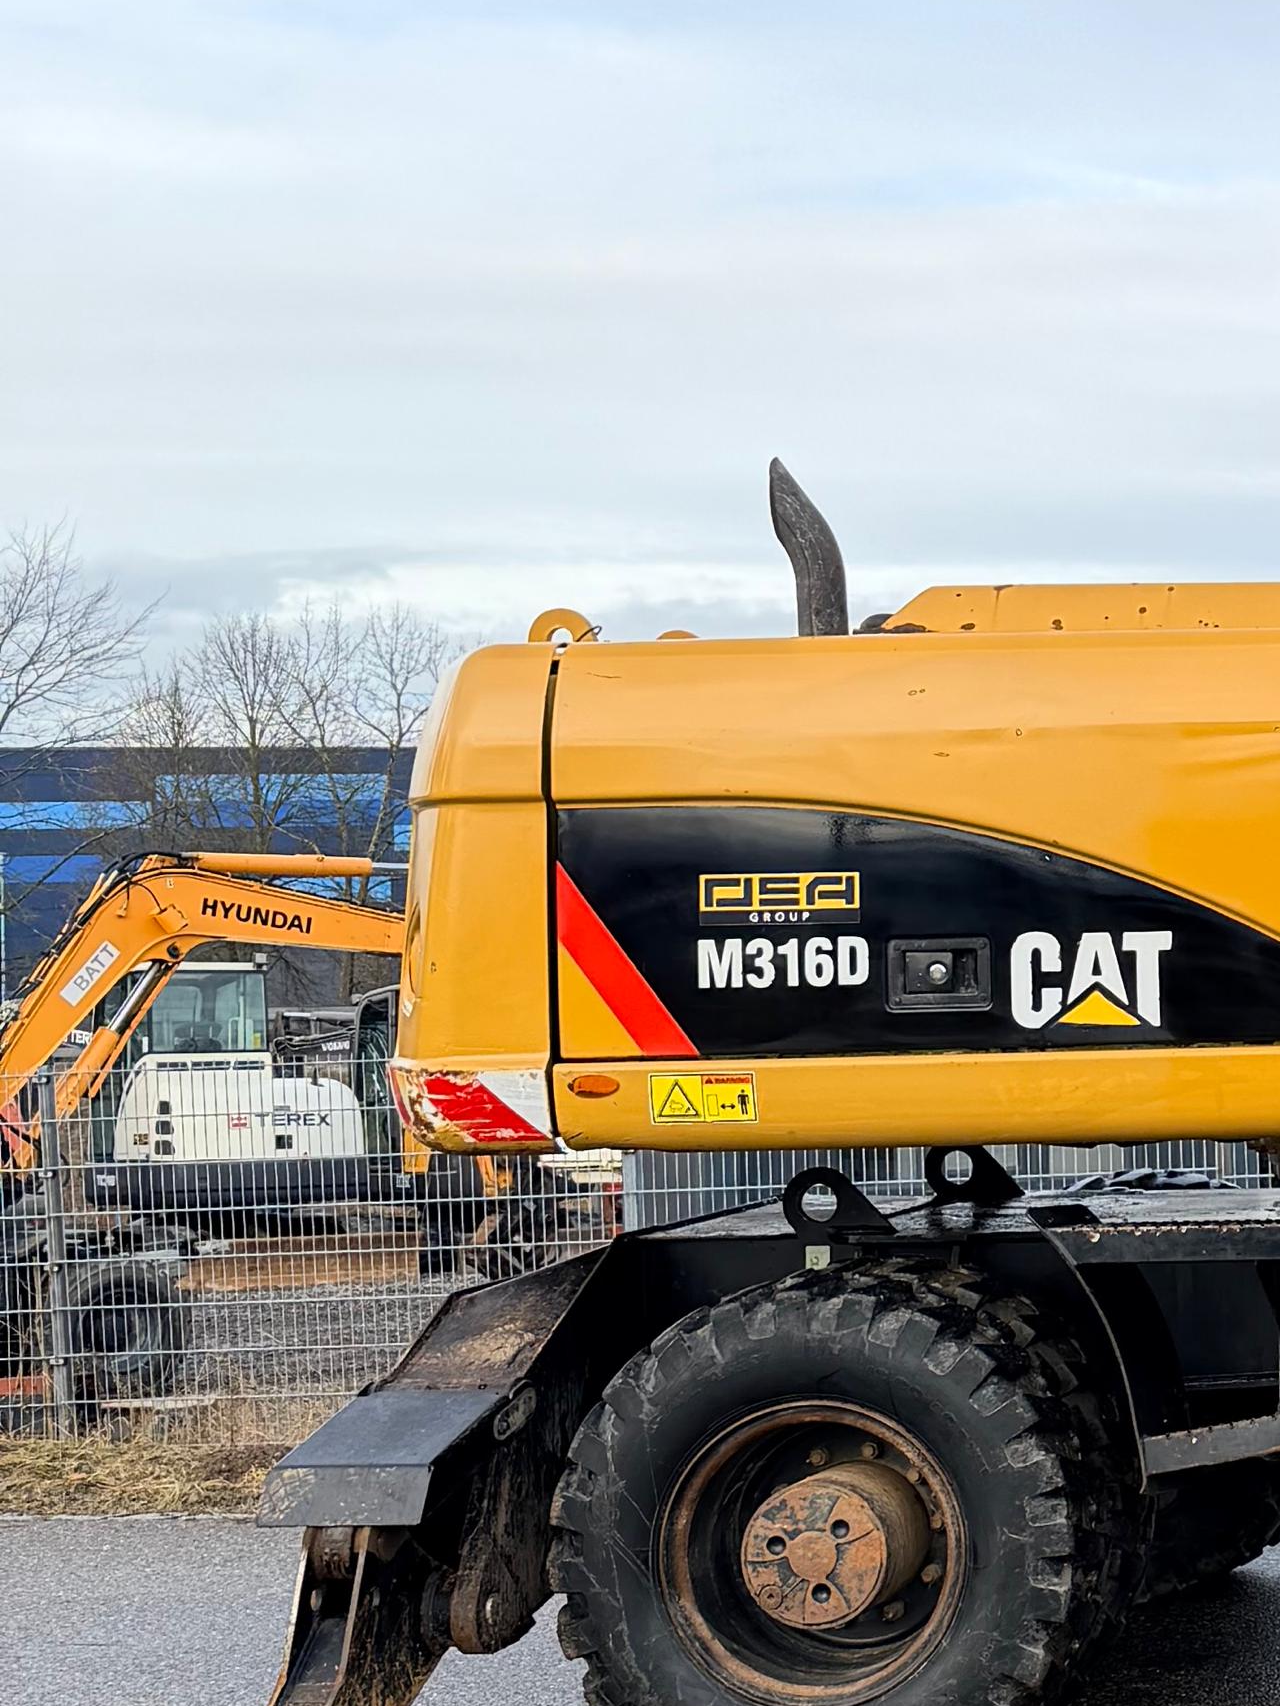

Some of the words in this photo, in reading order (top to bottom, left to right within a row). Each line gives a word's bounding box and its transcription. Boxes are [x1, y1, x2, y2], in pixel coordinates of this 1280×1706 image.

[200, 897, 313, 935] HYUNDAI
[748, 911, 811, 923] GROUP
[73, 943, 115, 991] BATT
[697, 935, 870, 989] M316D
[1010, 930, 1173, 1030] CAT
[321, 1040, 350, 1052] VOLVO
[254, 1112, 331, 1127] TEREX
